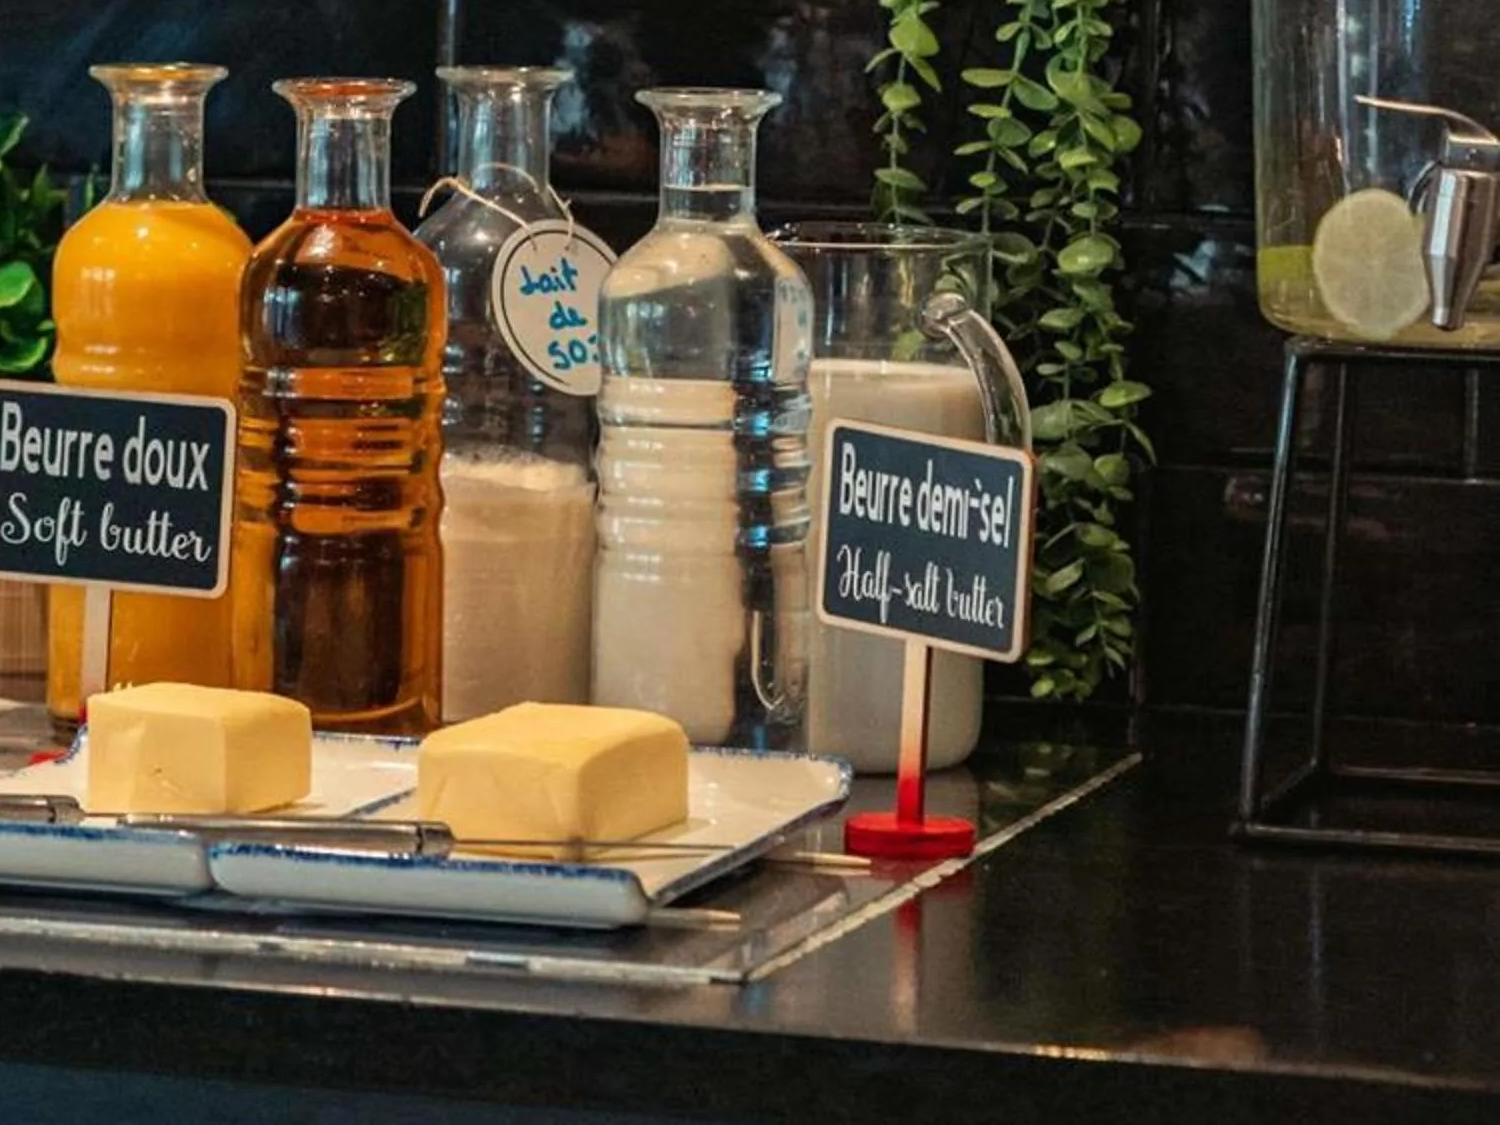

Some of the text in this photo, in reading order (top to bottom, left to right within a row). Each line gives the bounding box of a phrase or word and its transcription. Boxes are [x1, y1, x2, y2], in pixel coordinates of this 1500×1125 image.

[548, 300, 588, 330] de
[0, 401, 211, 491] Beurre doux
[839, 442, 913, 527] Beurre
[1, 492, 212, 567] Soft butter
[836, 544, 1004, 630] Half-salt butter
